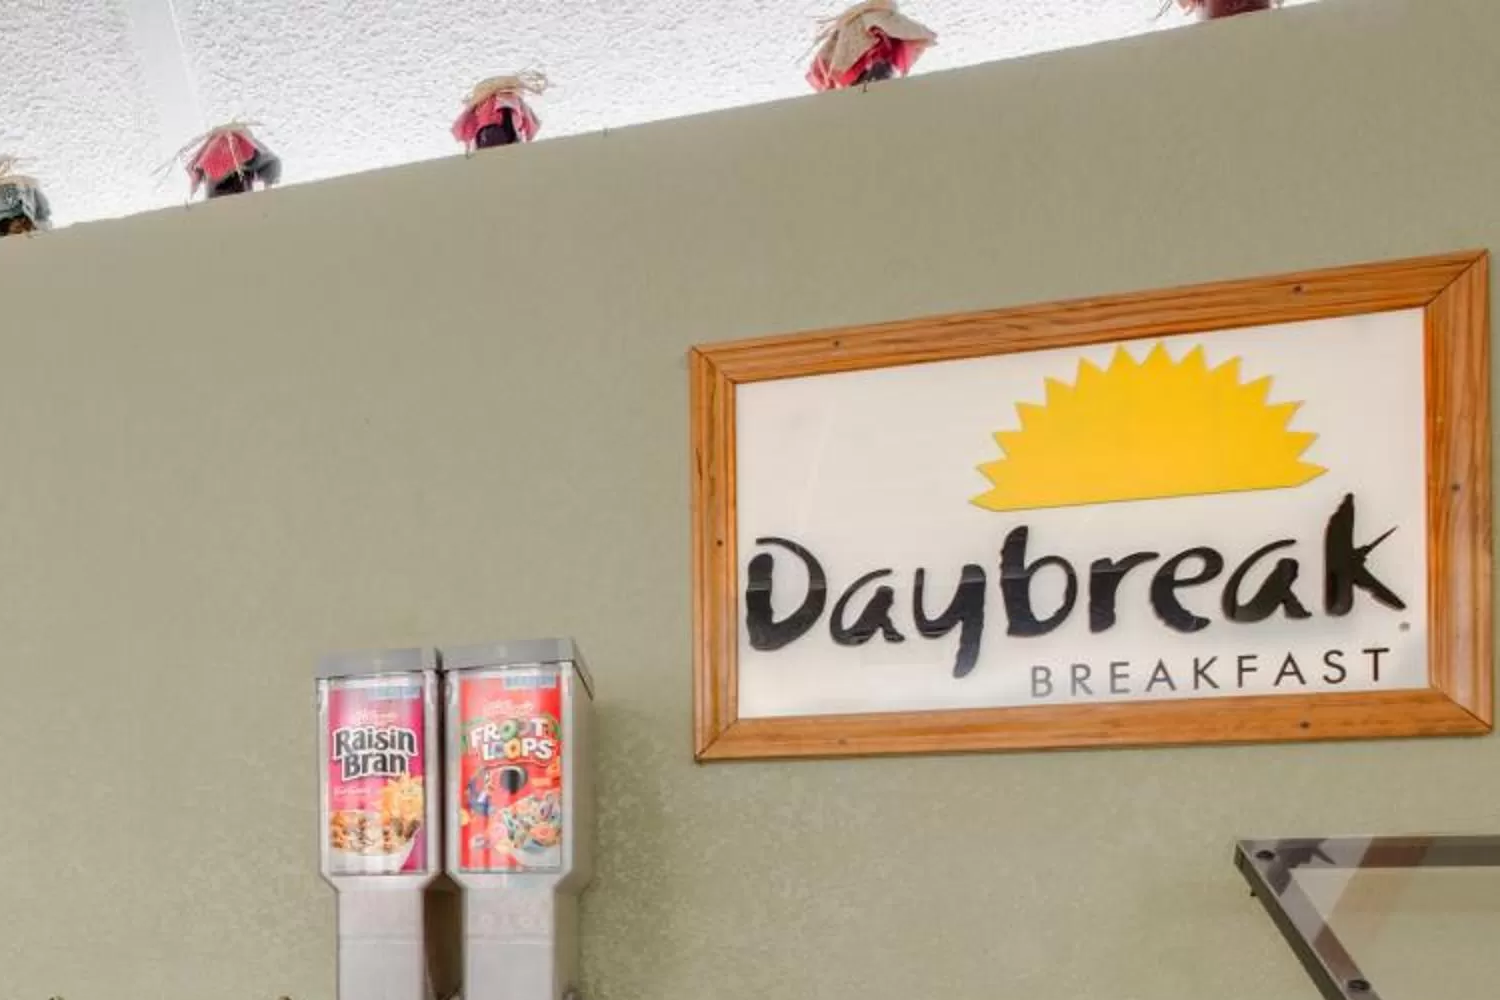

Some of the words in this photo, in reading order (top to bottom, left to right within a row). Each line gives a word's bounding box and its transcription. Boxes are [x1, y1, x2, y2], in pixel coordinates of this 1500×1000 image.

[746, 492, 1406, 679] Daybreak
[1031, 647, 1391, 697] BREAKFAST
[335, 727, 415, 757] Raisin
[344, 752, 407, 779] Bran
